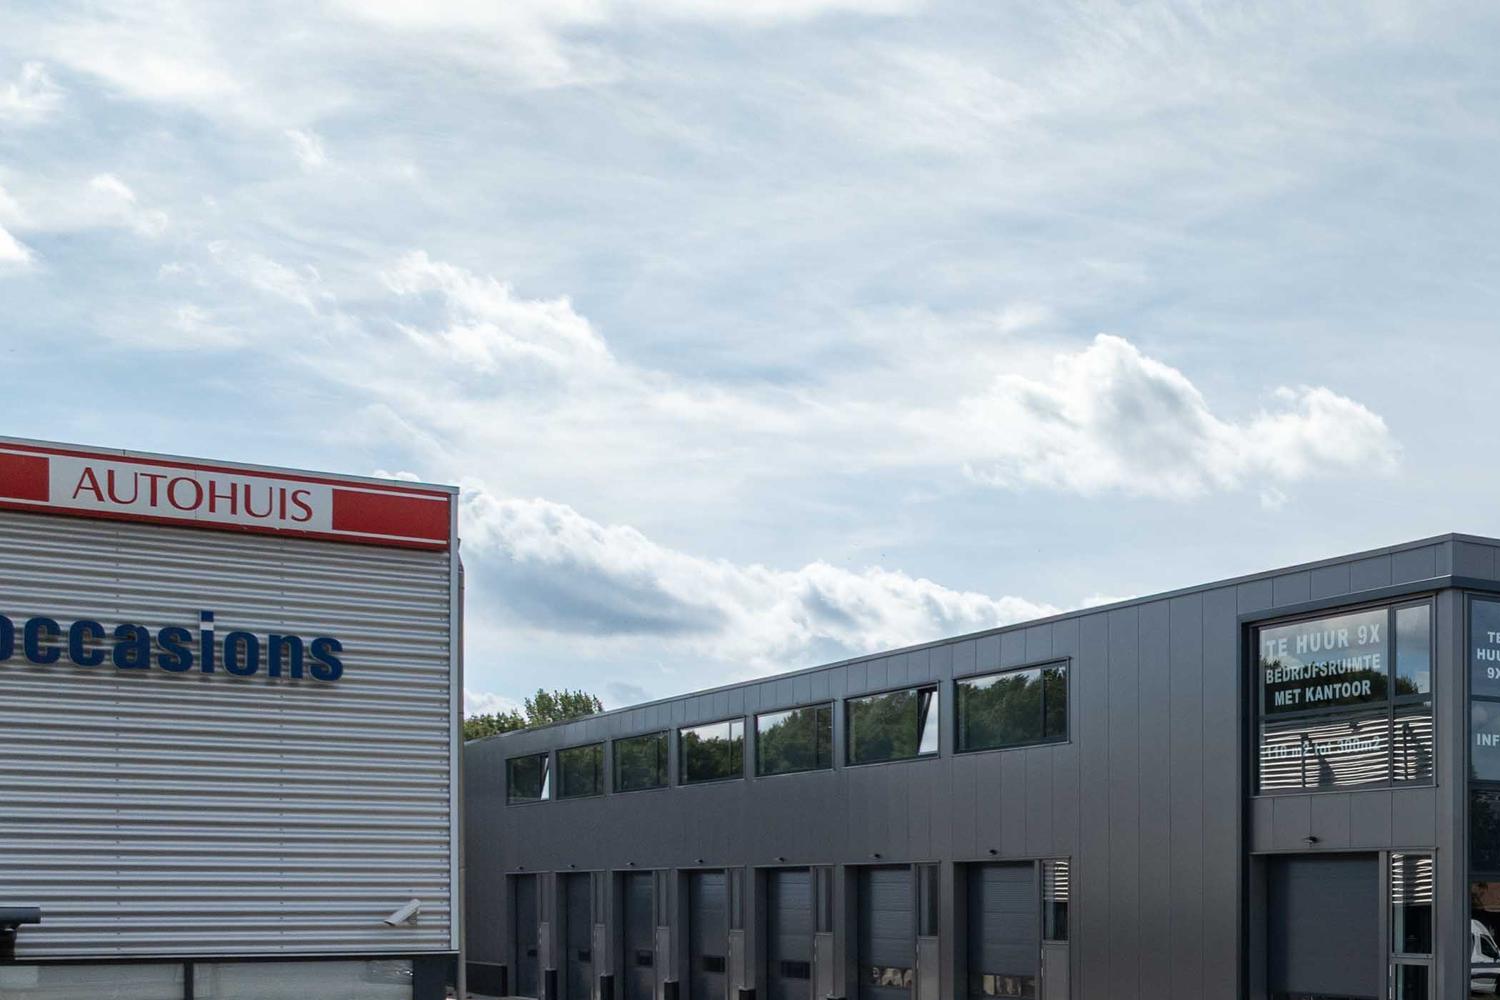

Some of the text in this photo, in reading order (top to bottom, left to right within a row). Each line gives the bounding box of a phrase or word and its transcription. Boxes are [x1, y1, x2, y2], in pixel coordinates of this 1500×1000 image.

[73, 466, 313, 522] AUTOHUIS
[1266, 624, 1380, 659] TE HUUR 9X
[1266, 653, 1381, 685] BEDRIJFSRUIMTE
[1275, 679, 1371, 707] MET KANTOOR
